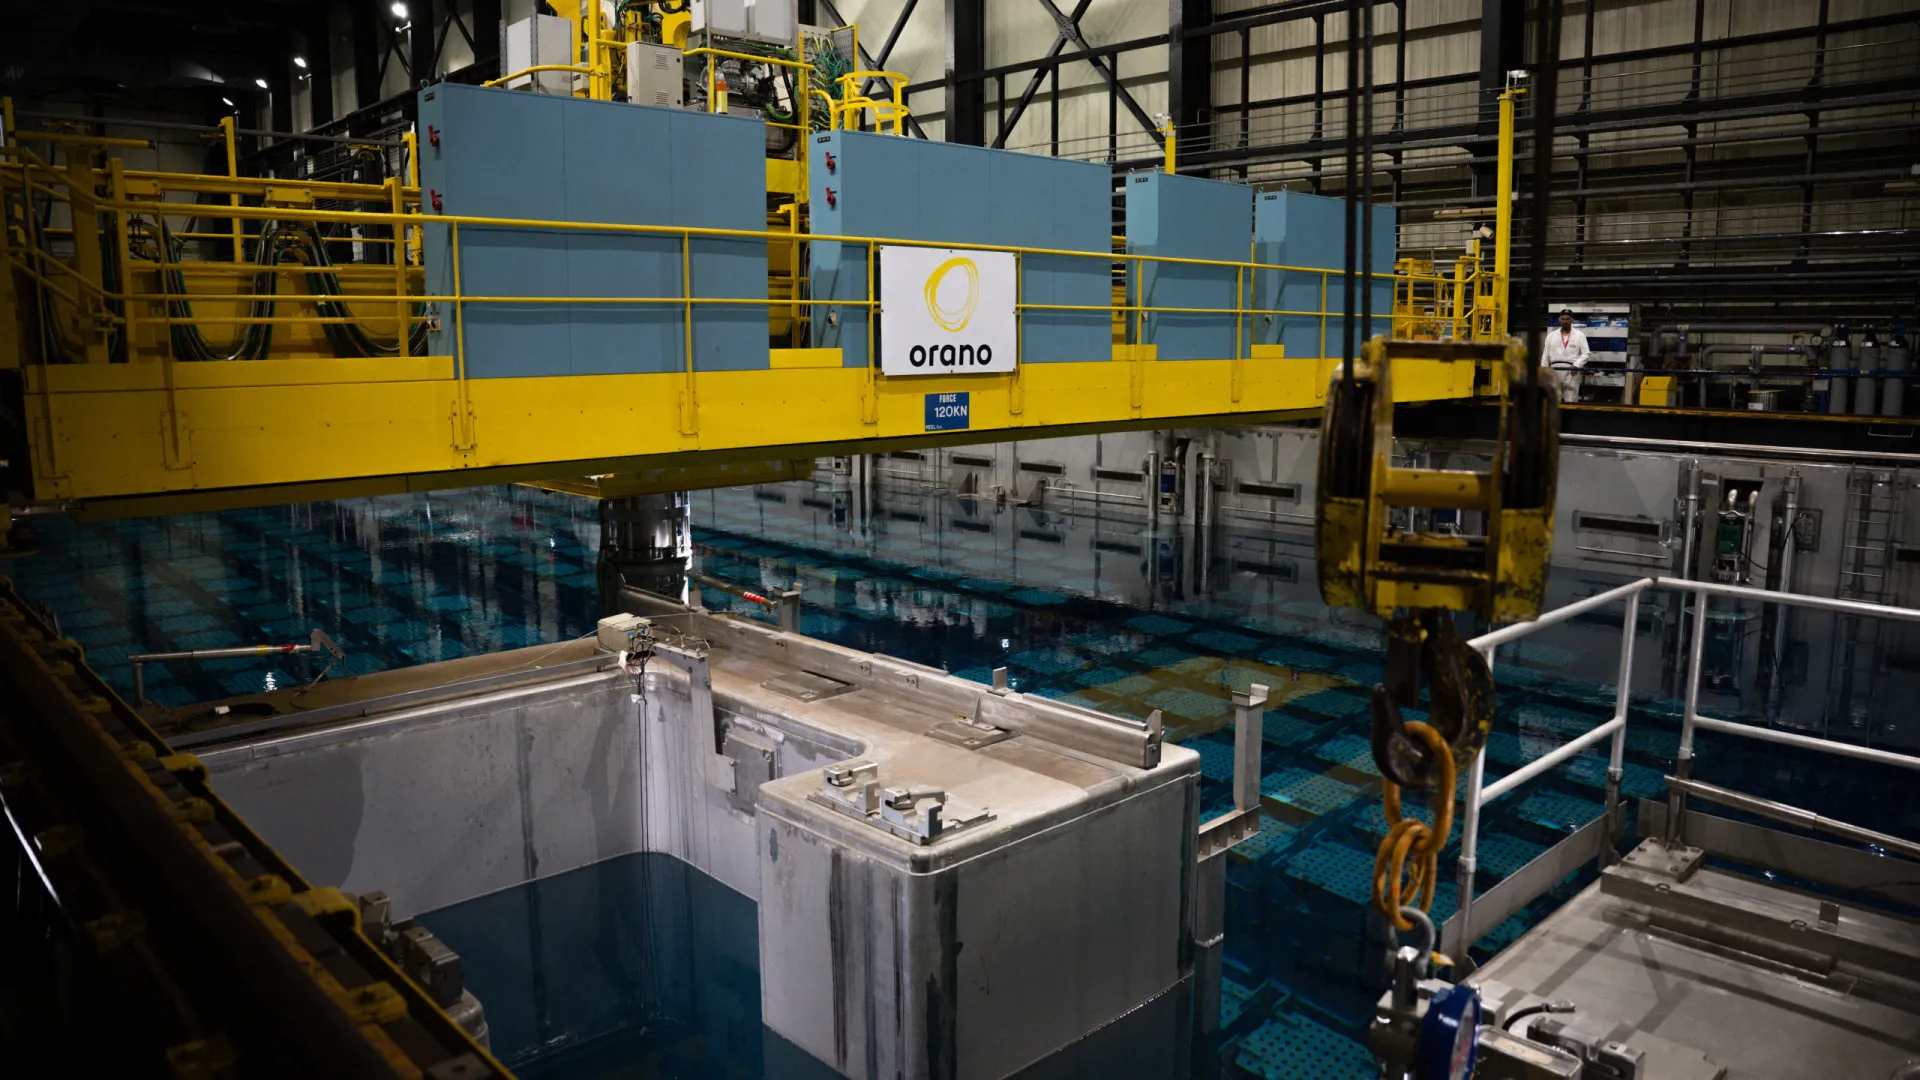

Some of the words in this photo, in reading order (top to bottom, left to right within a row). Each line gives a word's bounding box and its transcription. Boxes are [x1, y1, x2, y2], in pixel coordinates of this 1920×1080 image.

[909, 344, 992, 367] orano
[939, 394, 957, 403] FORCE
[934, 405, 968, 418] 120KN
